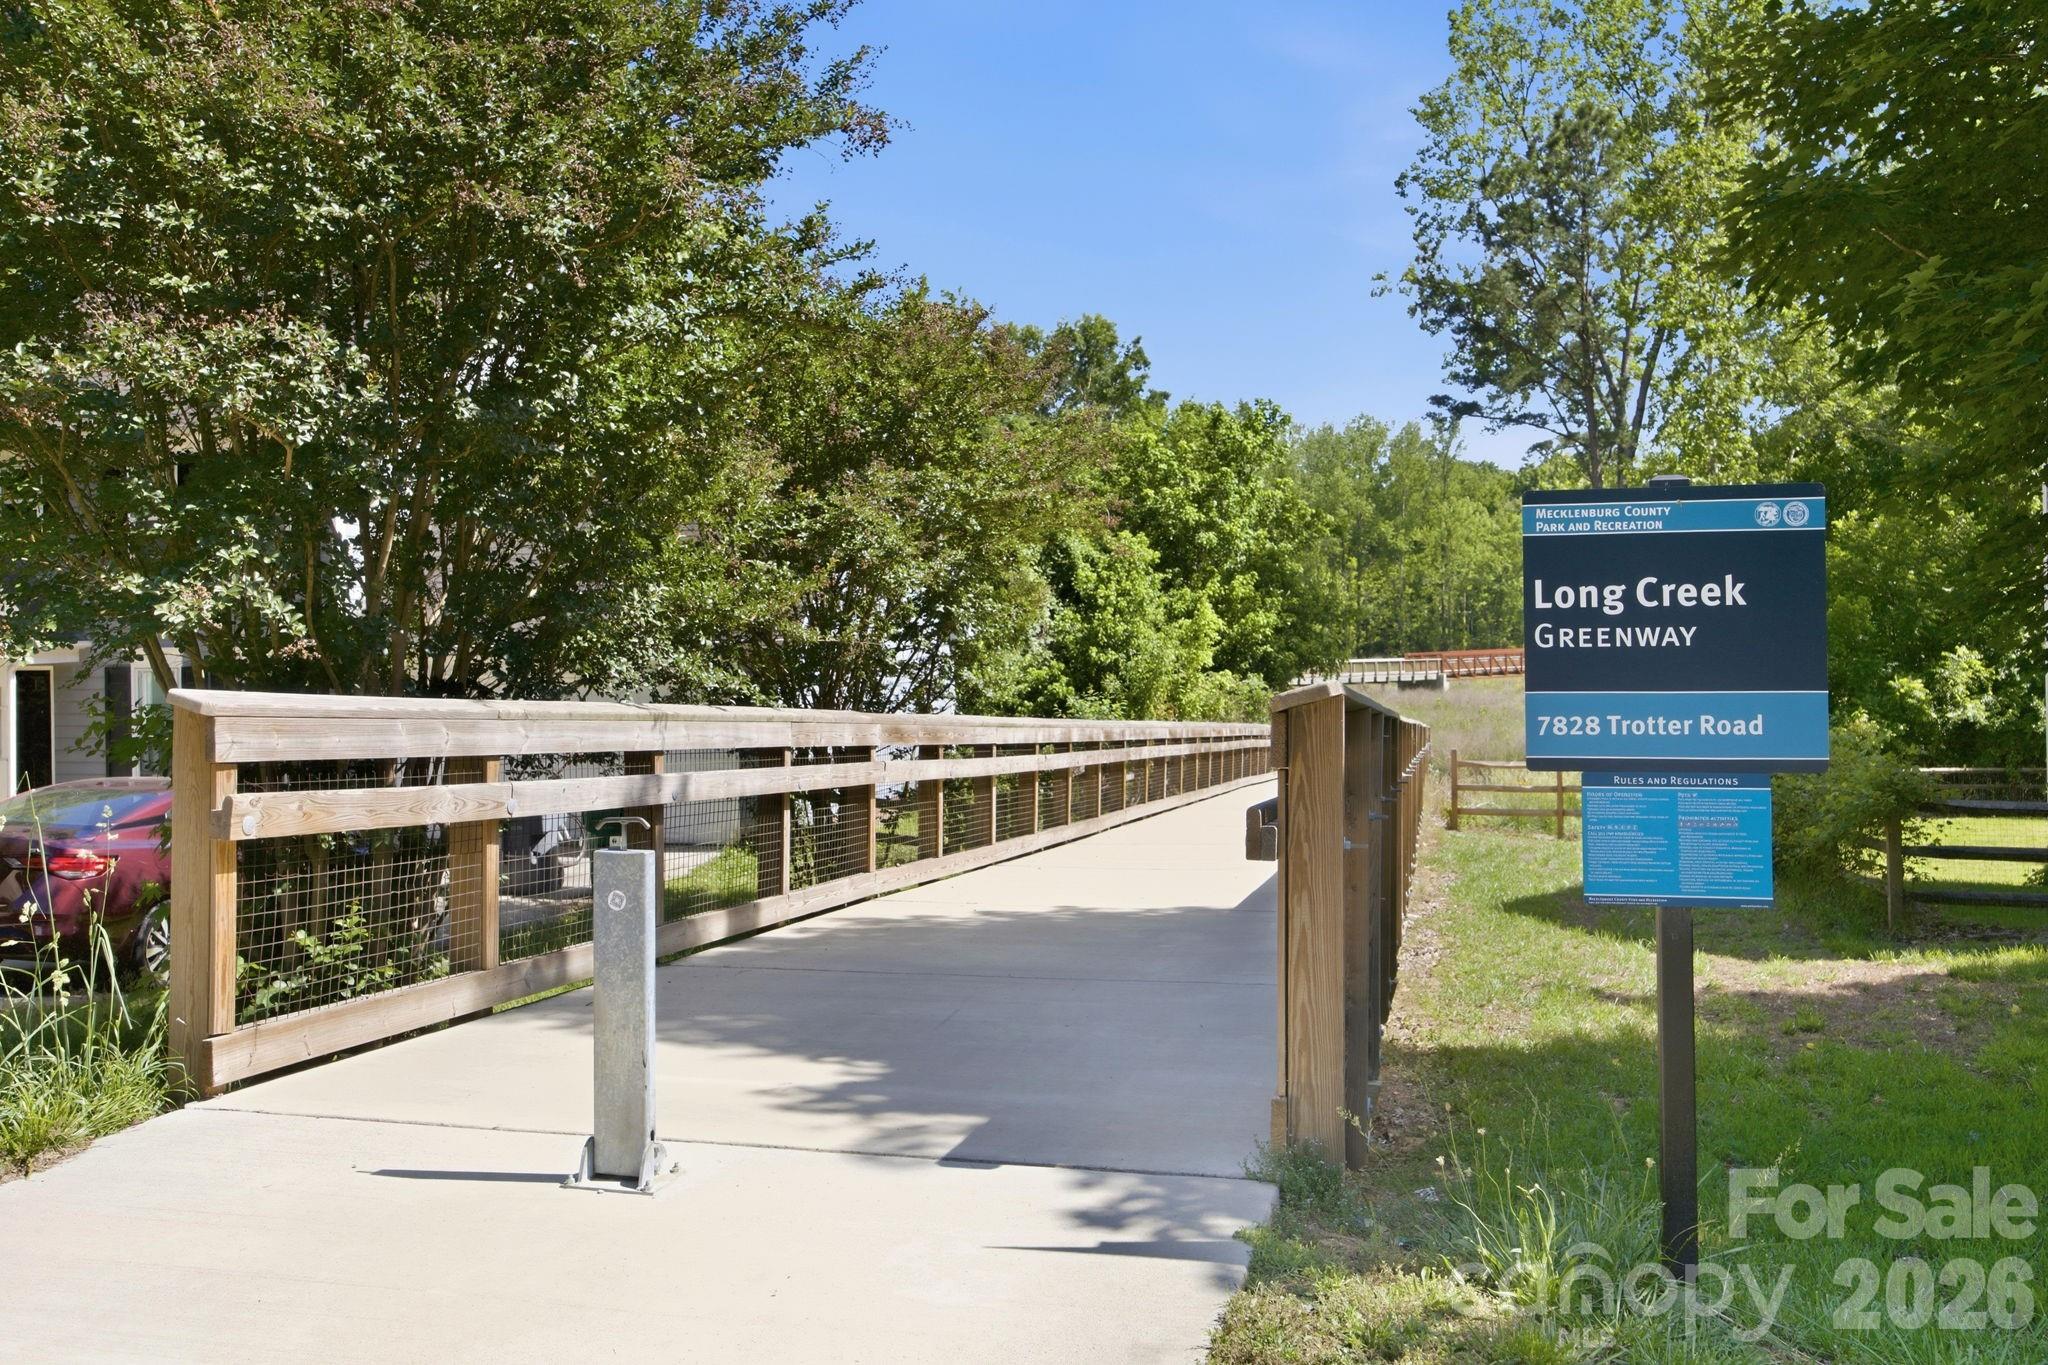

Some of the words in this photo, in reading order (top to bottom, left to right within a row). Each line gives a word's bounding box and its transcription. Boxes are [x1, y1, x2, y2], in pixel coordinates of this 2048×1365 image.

[1536, 507, 1620, 519] MECKLENBURG
[1624, 505, 1671, 517] COUNTY
[1536, 521, 1565, 532] PARK
[1568, 522, 1590, 532] AND
[1594, 520, 1663, 531] RECREATION
[1534, 579, 1626, 615] Long
[1636, 574, 1747, 608] Creek
[1534, 623, 1697, 648] GREENWAY
[1537, 715, 1600, 736] 7828
[1607, 714, 1692, 736] Trotter
[1700, 714, 1763, 736] Road
[1613, 776, 1644, 785] RULES
[1647, 777, 1667, 785] AND
[1670, 776, 1739, 786] REGULATIONS
